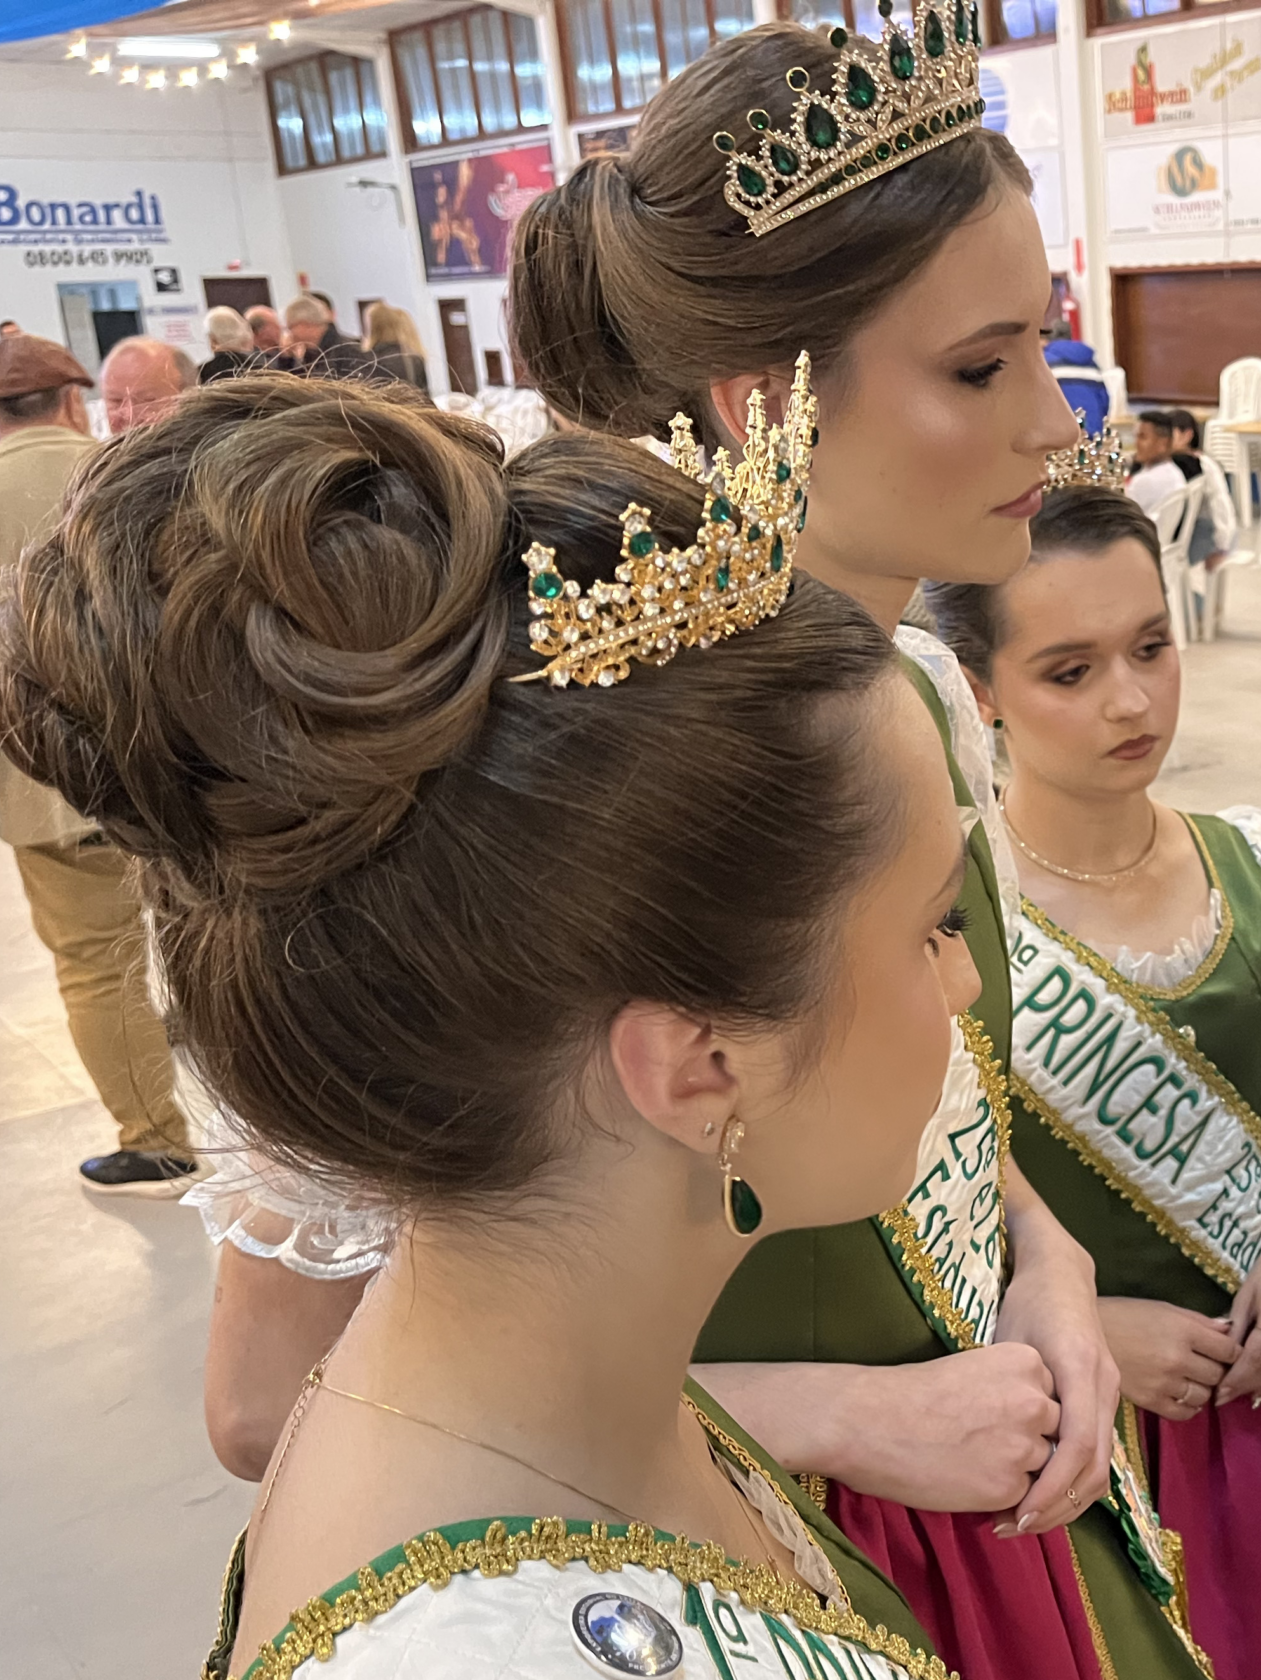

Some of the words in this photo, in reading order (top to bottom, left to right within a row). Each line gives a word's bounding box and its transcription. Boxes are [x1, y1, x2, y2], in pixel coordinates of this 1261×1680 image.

[0, 184, 163, 227] Bonardi
[1012, 964, 1221, 1186] PRINCESA
[904, 1158, 995, 1344] Estadual
